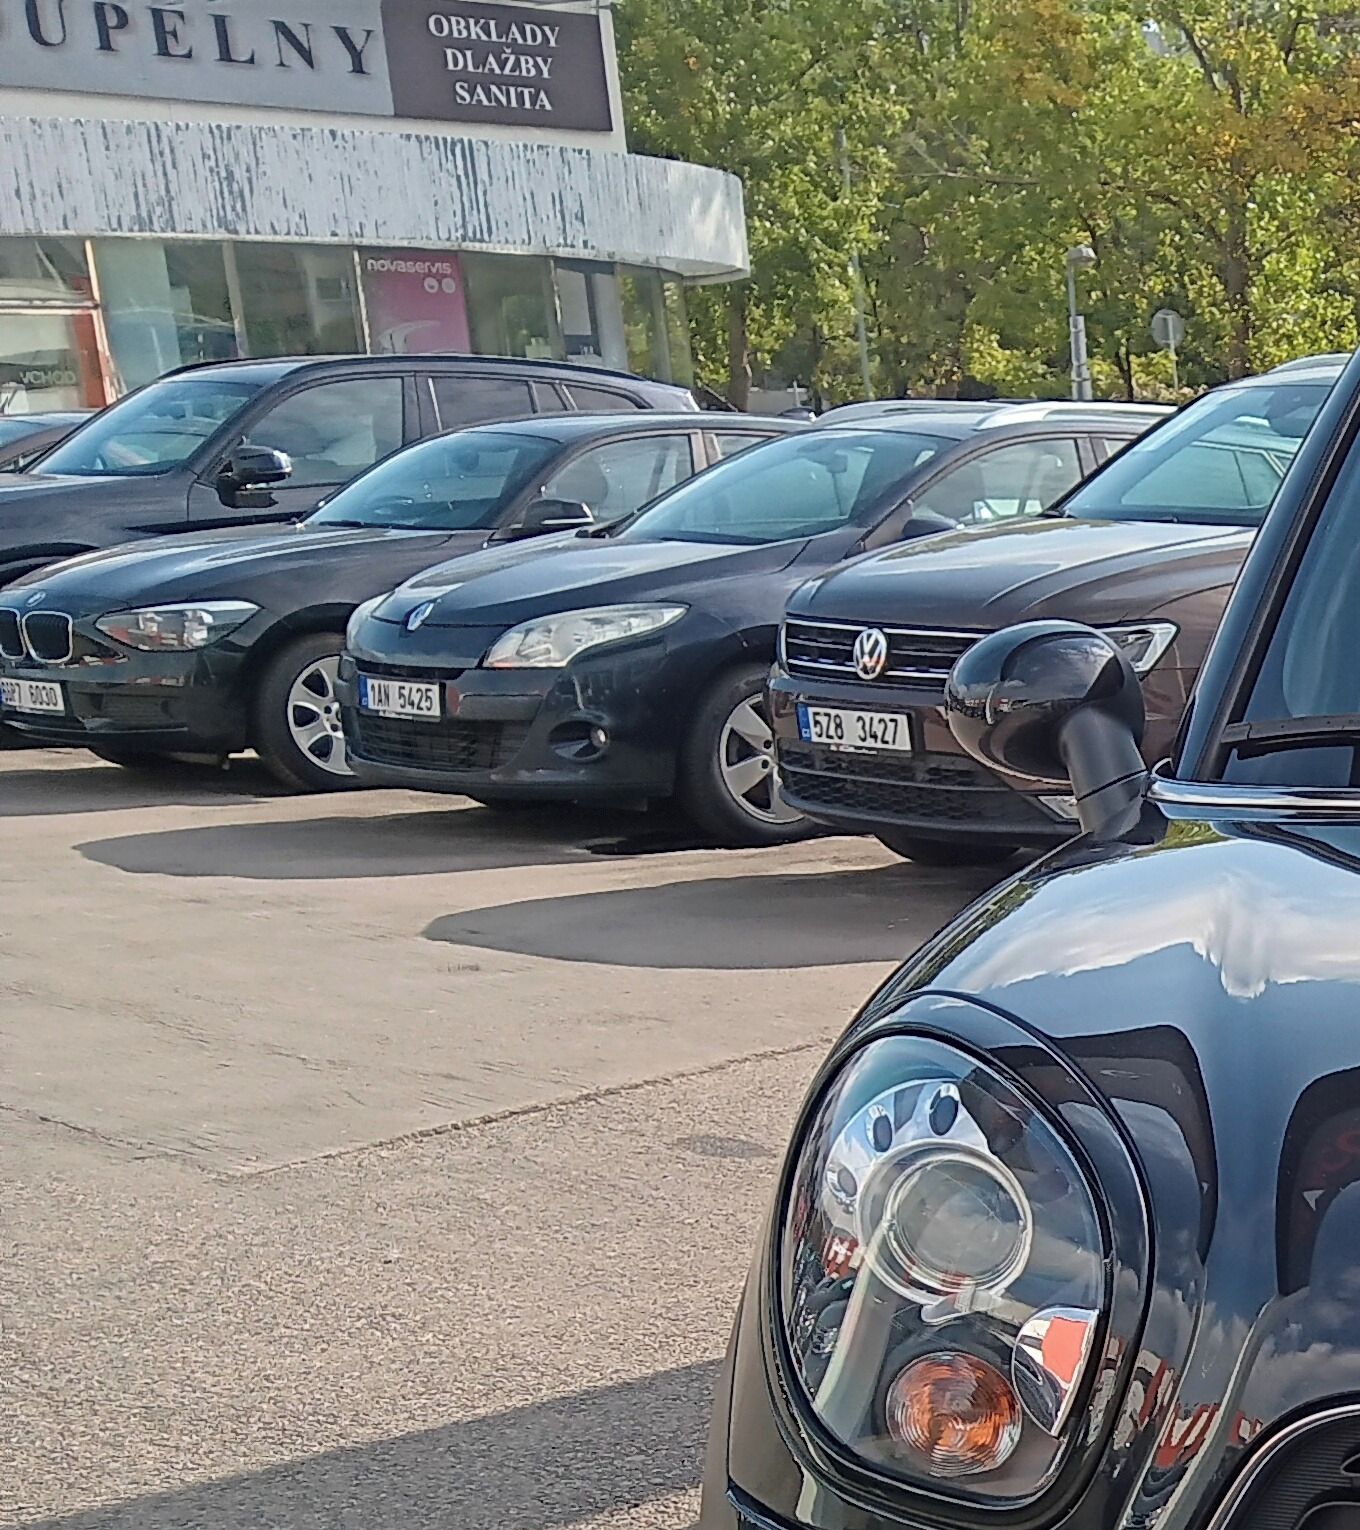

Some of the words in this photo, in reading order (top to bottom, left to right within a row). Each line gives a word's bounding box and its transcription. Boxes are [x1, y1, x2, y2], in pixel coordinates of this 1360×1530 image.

[428, 14, 560, 47] OBKLADY
[444, 46, 553, 78] DLAŽBY
[455, 81, 553, 111] SANITA
[367, 259, 453, 274] novaservis
[371, 683, 390, 708] 1AN
[398, 685, 433, 711] 5425
[812, 711, 844, 740] 5Z8
[856, 715, 898, 746] 3427
